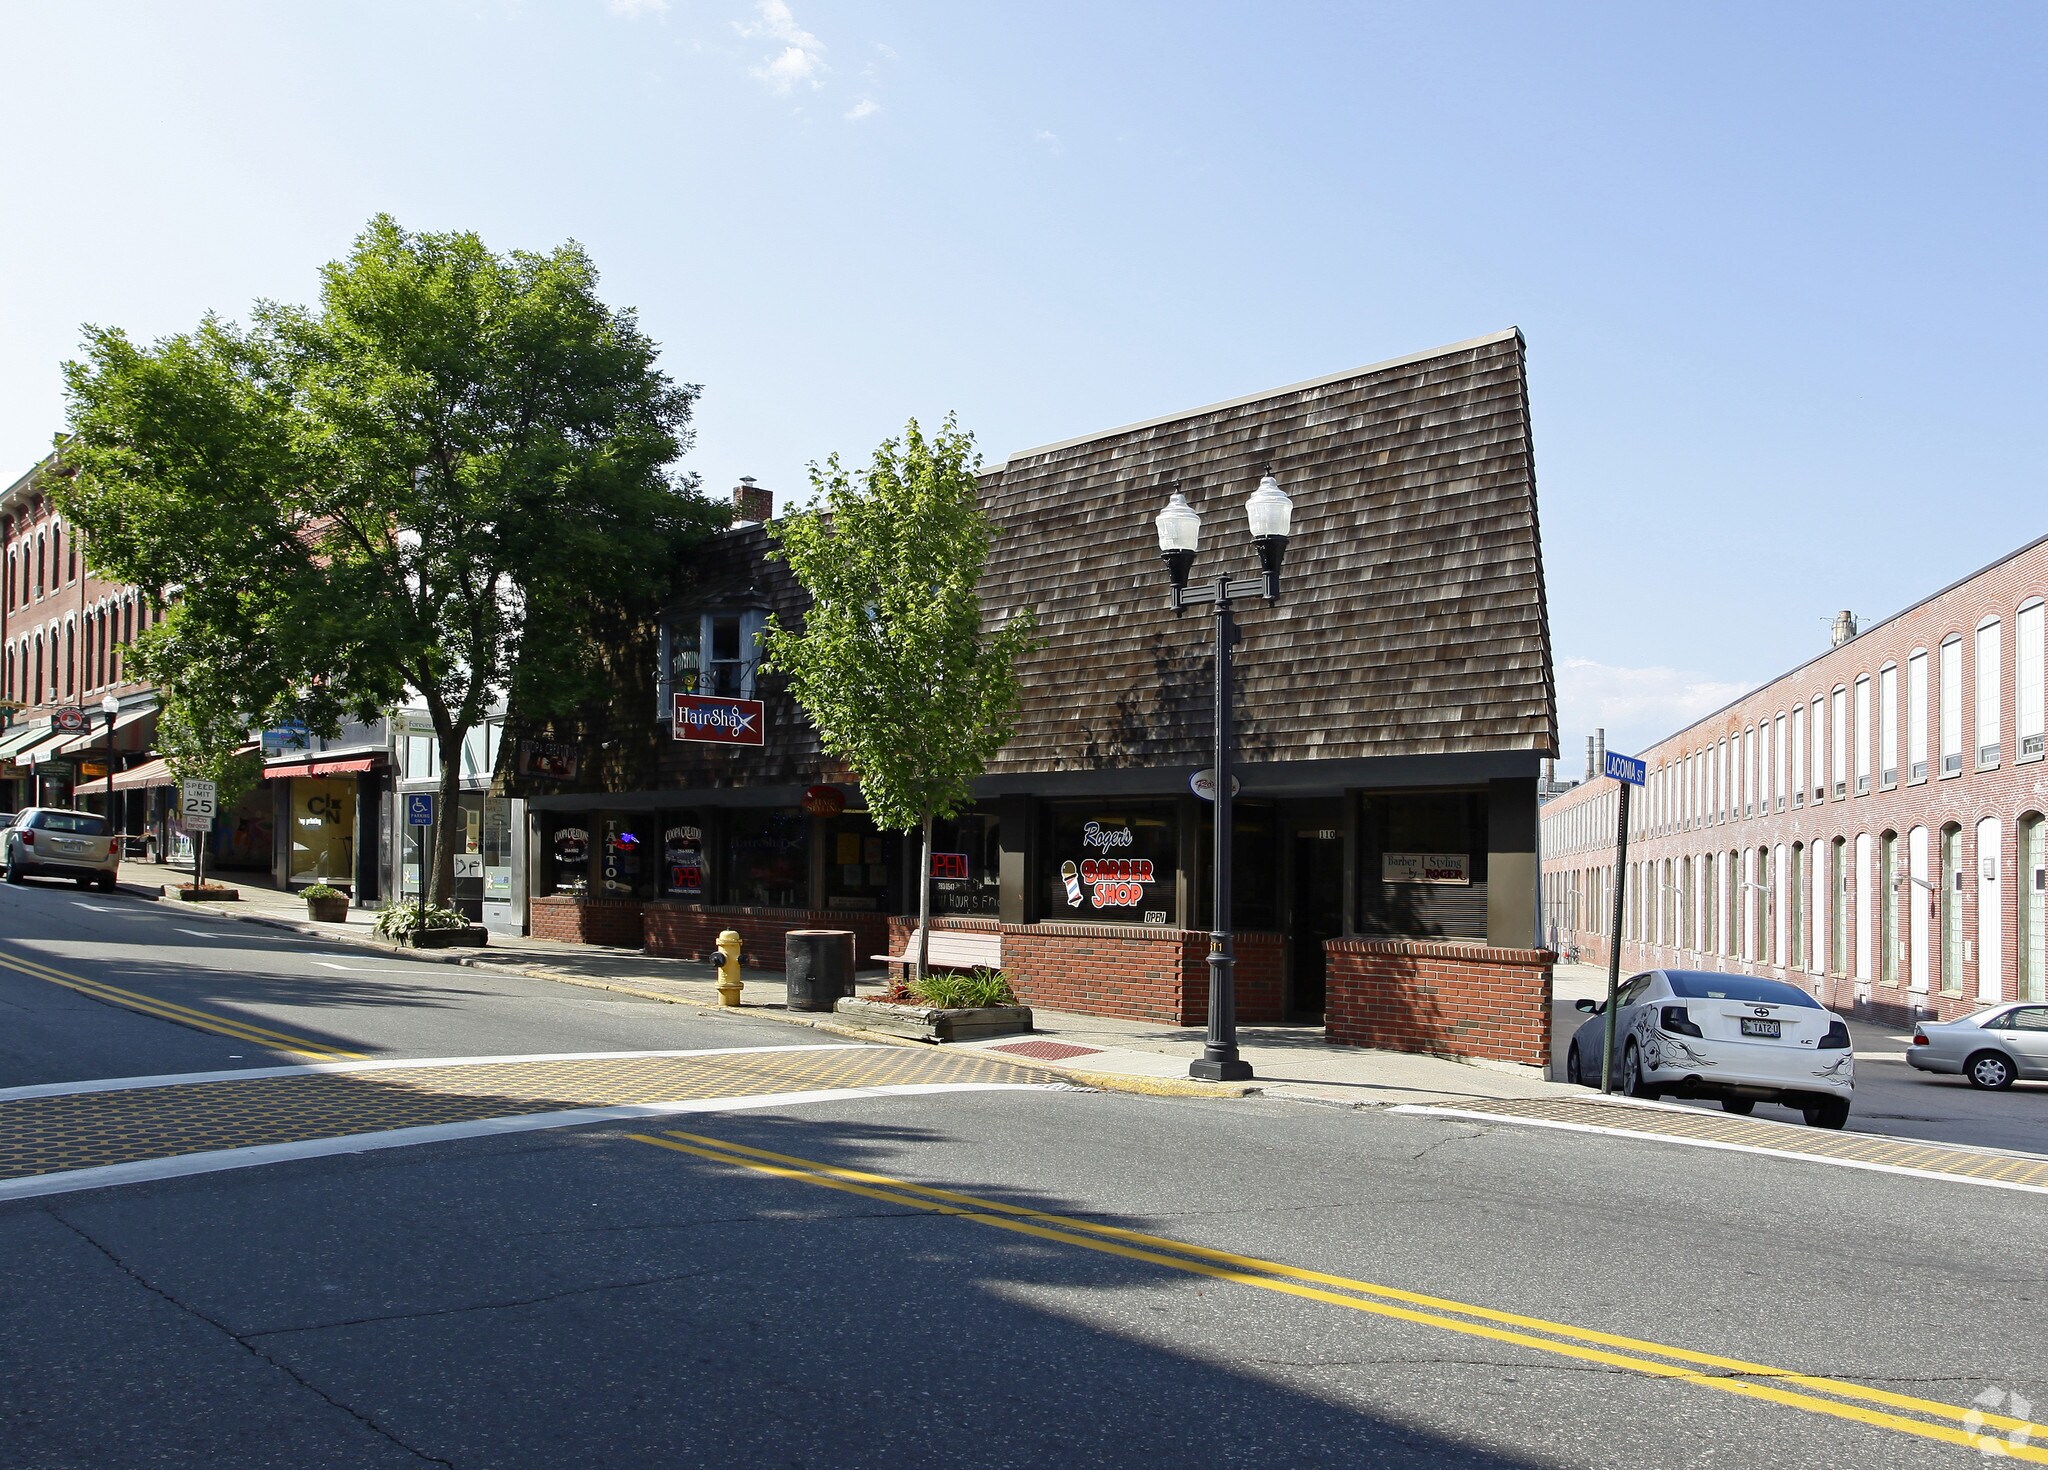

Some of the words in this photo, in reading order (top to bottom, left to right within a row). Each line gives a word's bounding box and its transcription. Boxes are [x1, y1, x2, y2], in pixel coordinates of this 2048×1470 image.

[673, 651, 700, 674] TANNIN
[1607, 755, 1635, 781] LACONIA
[186, 782, 214, 791] SPEED
[186, 798, 212, 813] 25
[1083, 821, 1133, 855] Roger's
[1320, 830, 1335, 839] 110
[605, 820, 617, 890] TATTOO
[1388, 855, 1417, 867] Barber
[1429, 856, 1462, 869] Styling
[673, 867, 701, 888] OPEN
[1080, 858, 1156, 885] BARBER
[1408, 867, 1417, 879] by
[1425, 868, 1467, 880] ROGER
[1091, 882, 1144, 909] SHOP
[1145, 911, 1166, 923] OPEN
